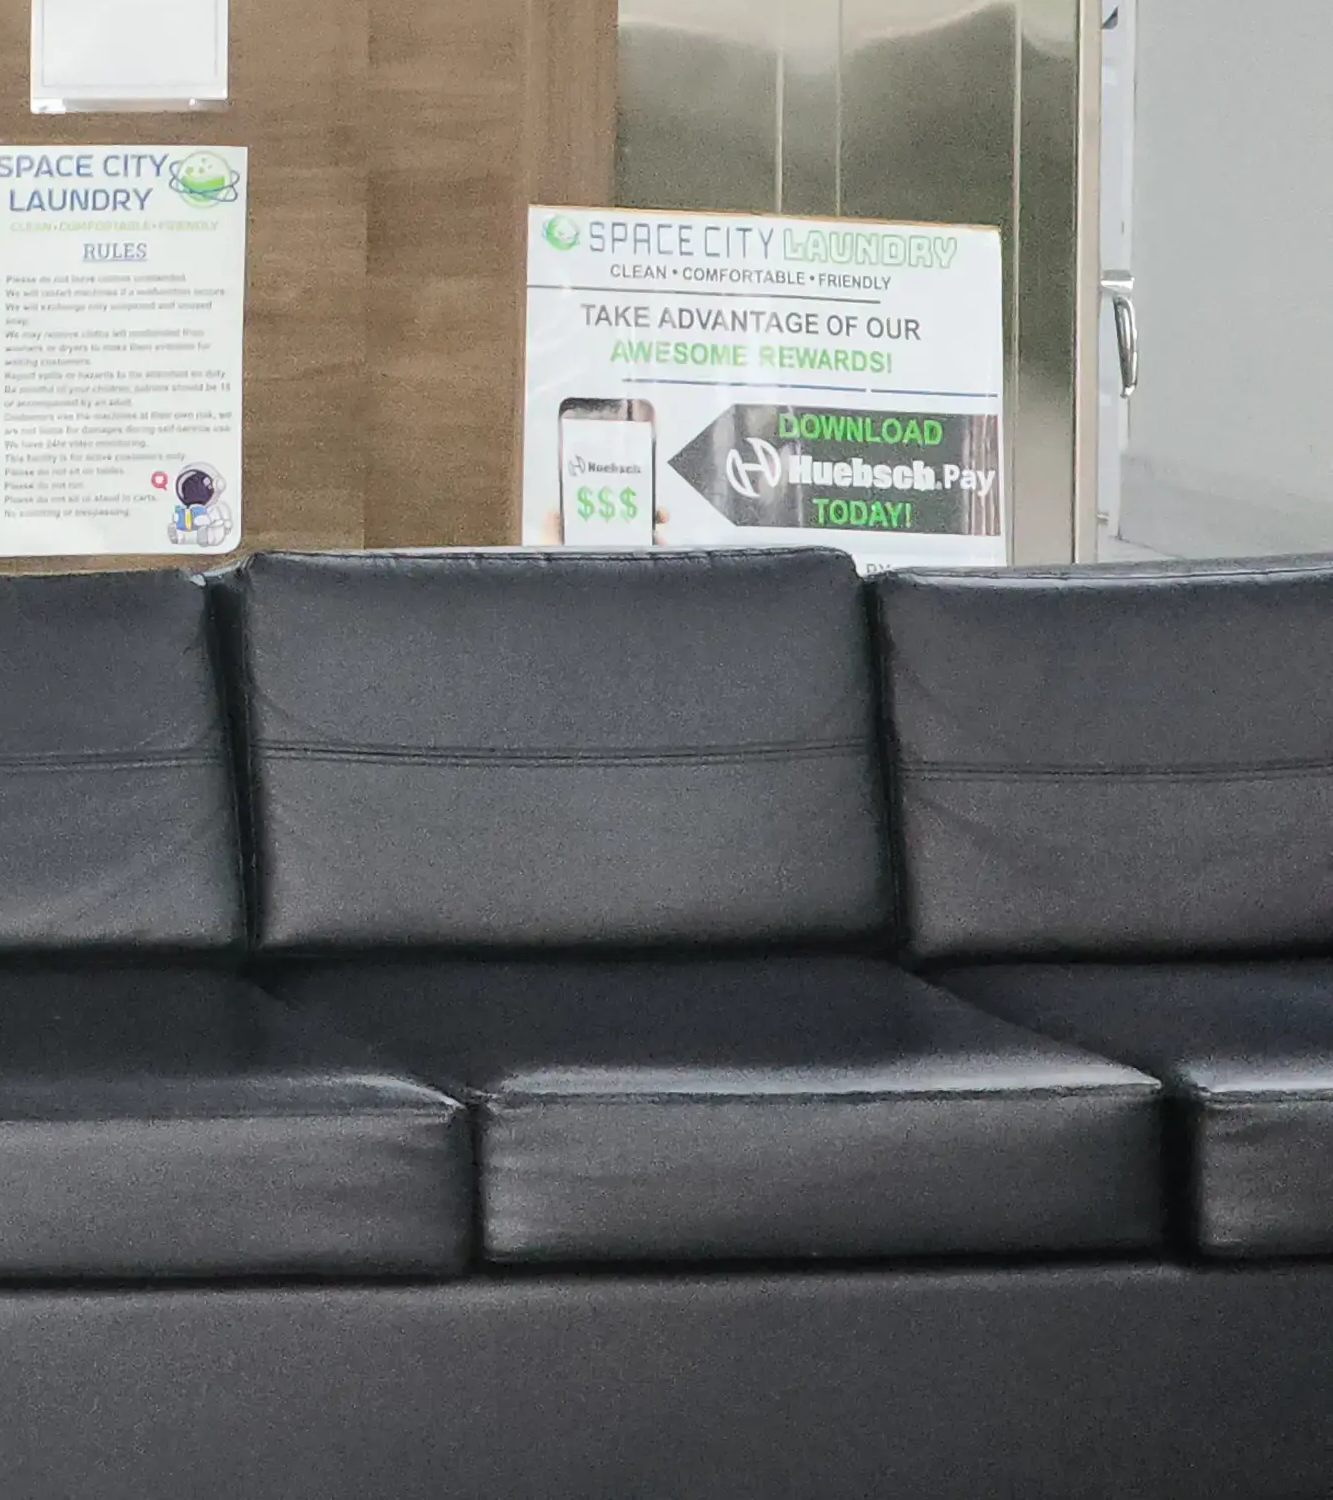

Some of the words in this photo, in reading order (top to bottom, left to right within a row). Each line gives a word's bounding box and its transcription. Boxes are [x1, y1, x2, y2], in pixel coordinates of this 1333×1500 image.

[102, 153, 170, 177] CITY
[8, 187, 153, 212] LAUNDRY
[82, 242, 148, 261] RULES
[588, 221, 694, 257] SPACE
[704, 225, 775, 259] CITY
[782, 228, 958, 269] LAUNDRY
[609, 264, 667, 280] CLEAN
[682, 266, 806, 286] COMFORTABLE
[818, 272, 892, 290] FRIENDLY
[579, 304, 650, 329] TAKE
[657, 307, 819, 336] ADVANTAGE
[826, 314, 859, 337] OF
[865, 317, 921, 341] OUR
[609, 340, 748, 367] AWESOME
[758, 346, 893, 374] REWARDS!
[778, 413, 943, 445] DOWNLOAD
[944, 463, 996, 497] Pay
[812, 498, 913, 529] TODAY!
